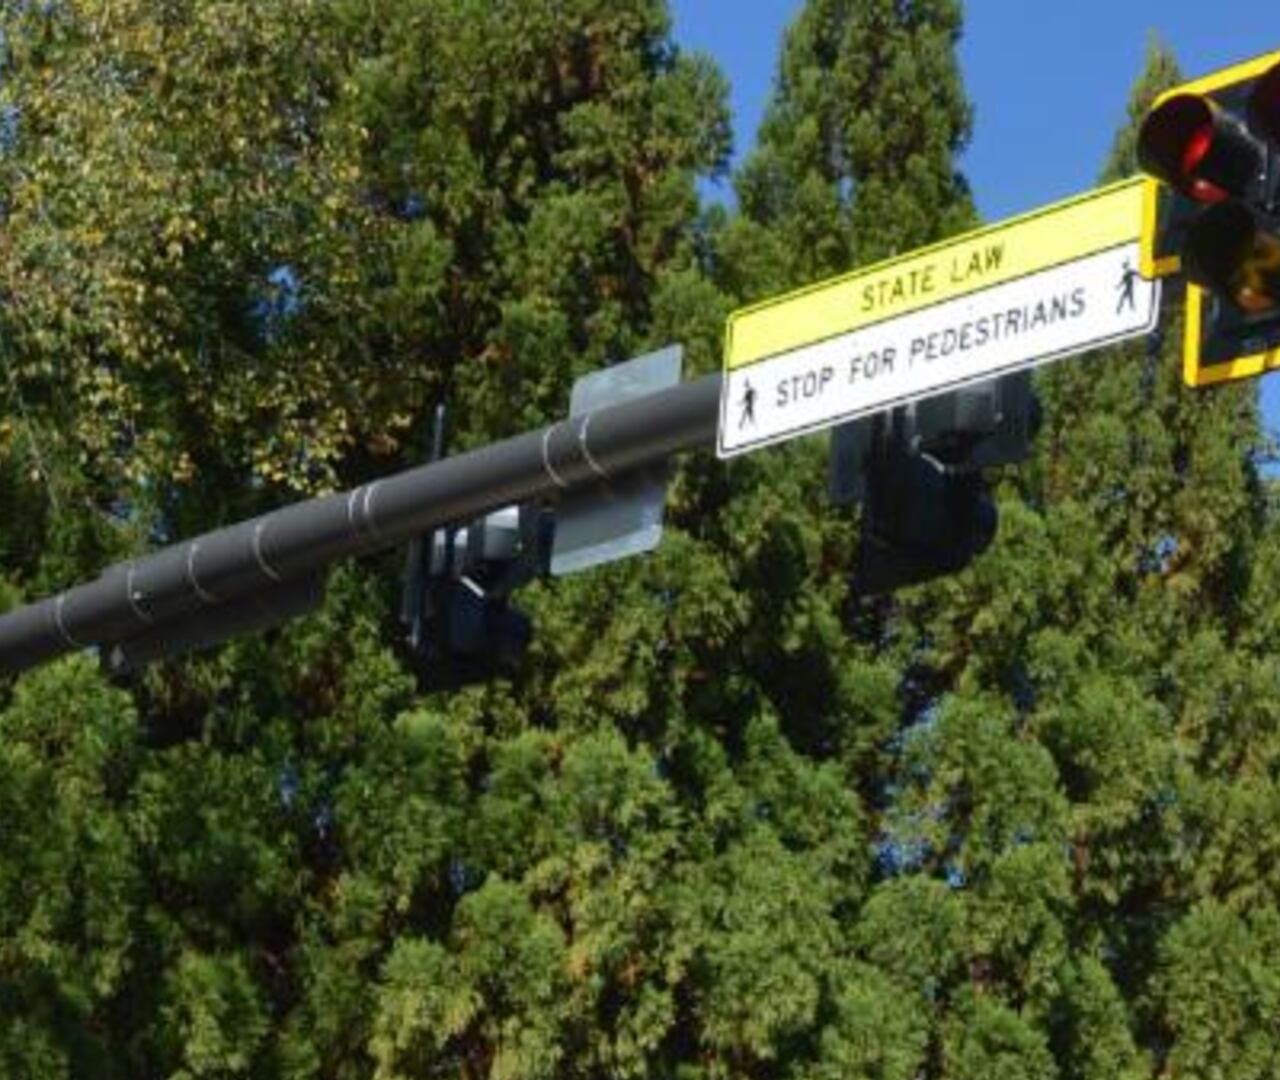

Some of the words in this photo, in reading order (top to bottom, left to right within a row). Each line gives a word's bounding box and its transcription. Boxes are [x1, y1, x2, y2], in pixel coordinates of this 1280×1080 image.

[860, 267, 936, 312] STATE
[949, 244, 1005, 283] LAW
[775, 367, 835, 408] STOP
[848, 346, 896, 385] FOR
[908, 287, 1087, 367] PEDESTRIANS
